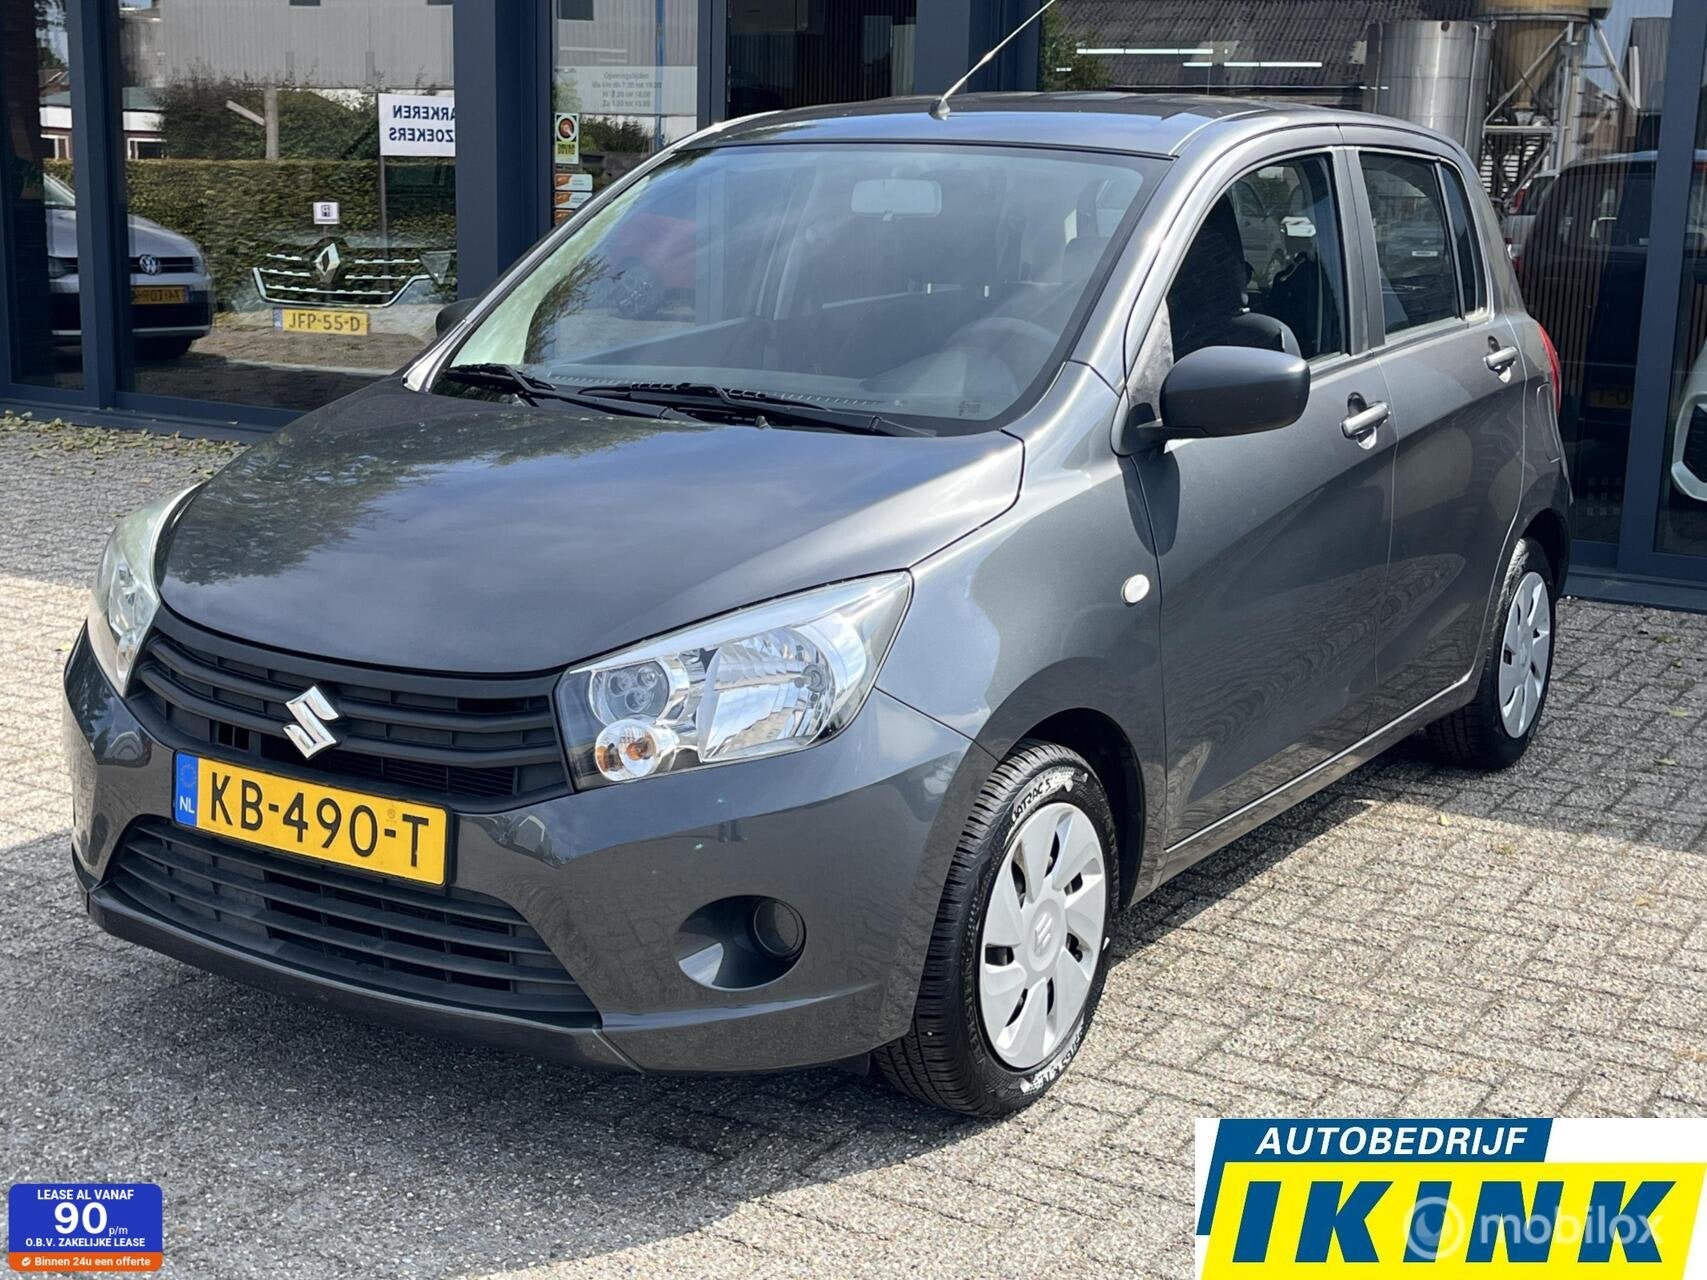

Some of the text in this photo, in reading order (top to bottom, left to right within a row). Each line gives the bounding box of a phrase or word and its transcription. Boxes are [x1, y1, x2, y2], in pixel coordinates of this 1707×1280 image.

[288, 312, 360, 331] JFP-55-D
[179, 797, 195, 815] NL
[210, 771, 430, 868] KB-490-T
